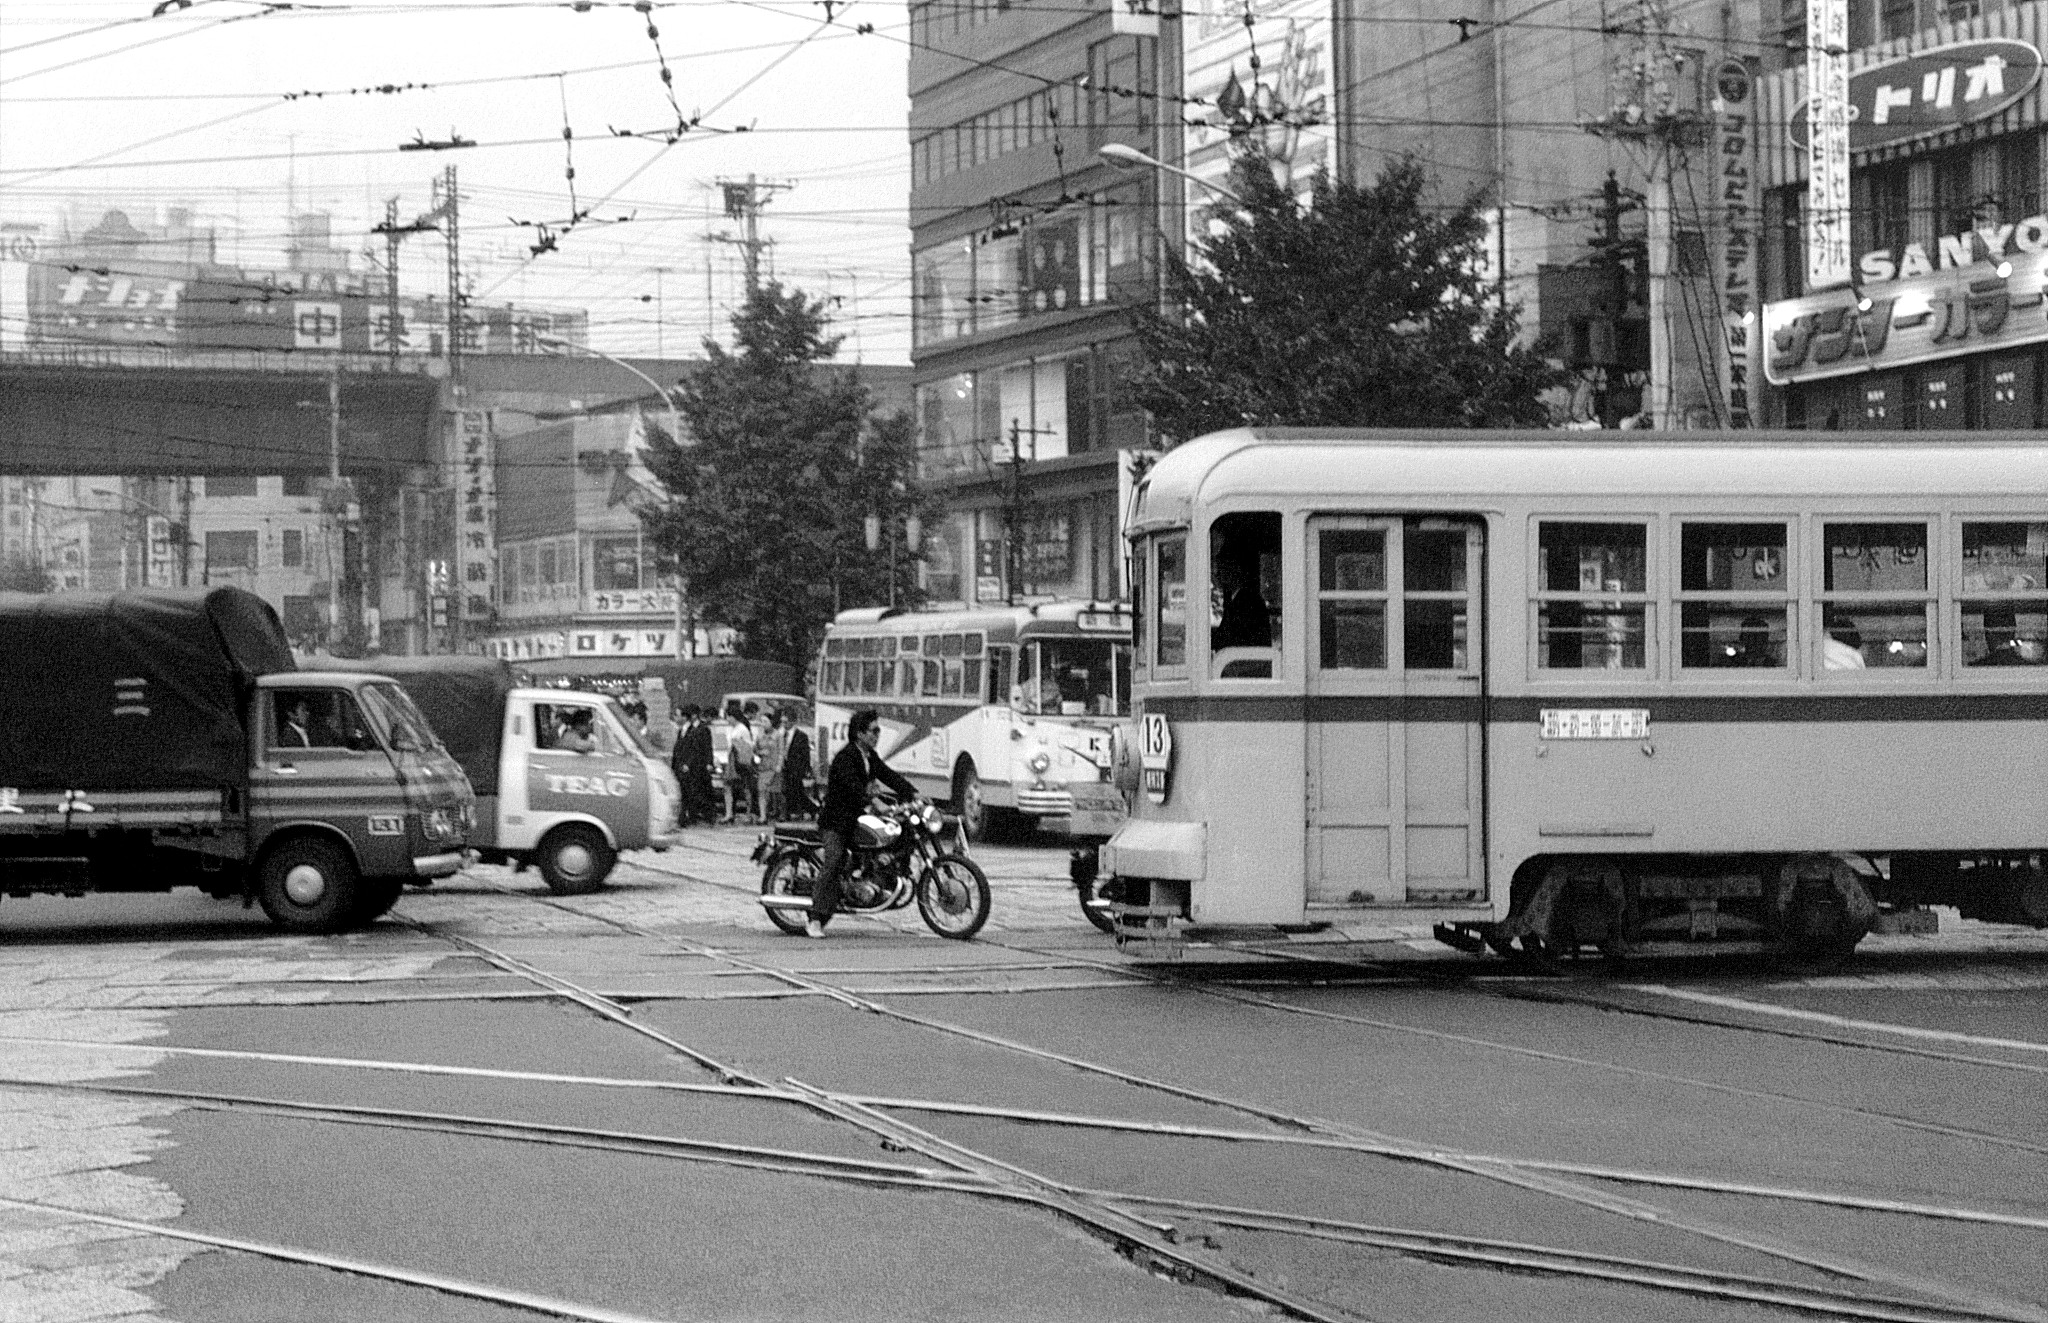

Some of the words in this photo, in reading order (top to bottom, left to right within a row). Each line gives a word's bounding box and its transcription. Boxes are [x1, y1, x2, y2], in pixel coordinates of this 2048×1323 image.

[1872, 55, 2008, 124] トリオ
[1860, 215, 2048, 284] SANYO
[1145, 716, 1163, 754] 13
[545, 773, 632, 797] TEAC
